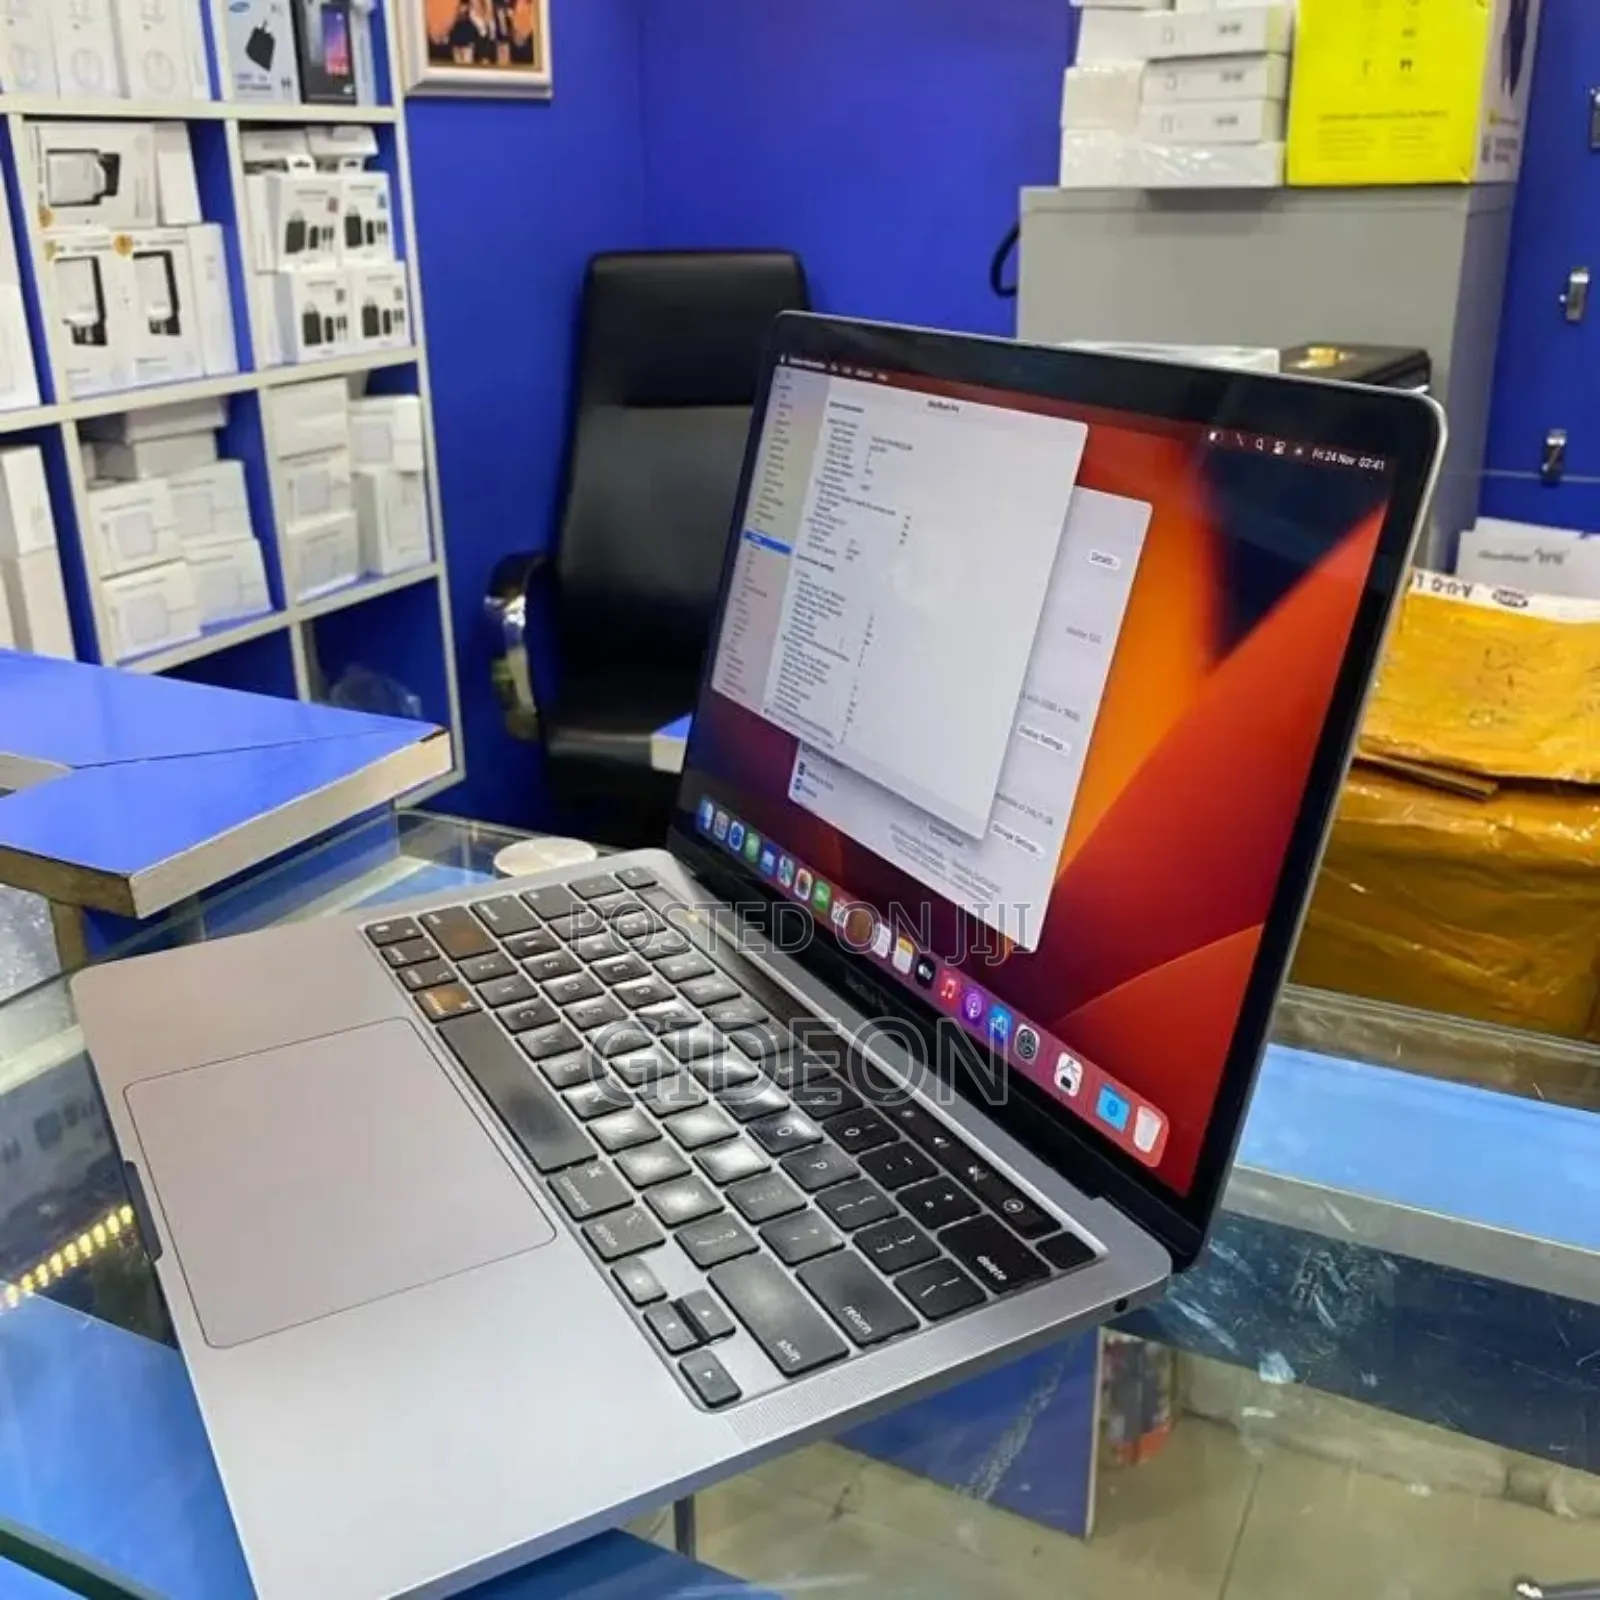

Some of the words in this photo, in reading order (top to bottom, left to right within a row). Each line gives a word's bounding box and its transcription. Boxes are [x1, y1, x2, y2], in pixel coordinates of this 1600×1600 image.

[976, 1255, 1008, 1281] delete
[842, 1305, 873, 1335] return
[776, 1339, 801, 1363] shift
